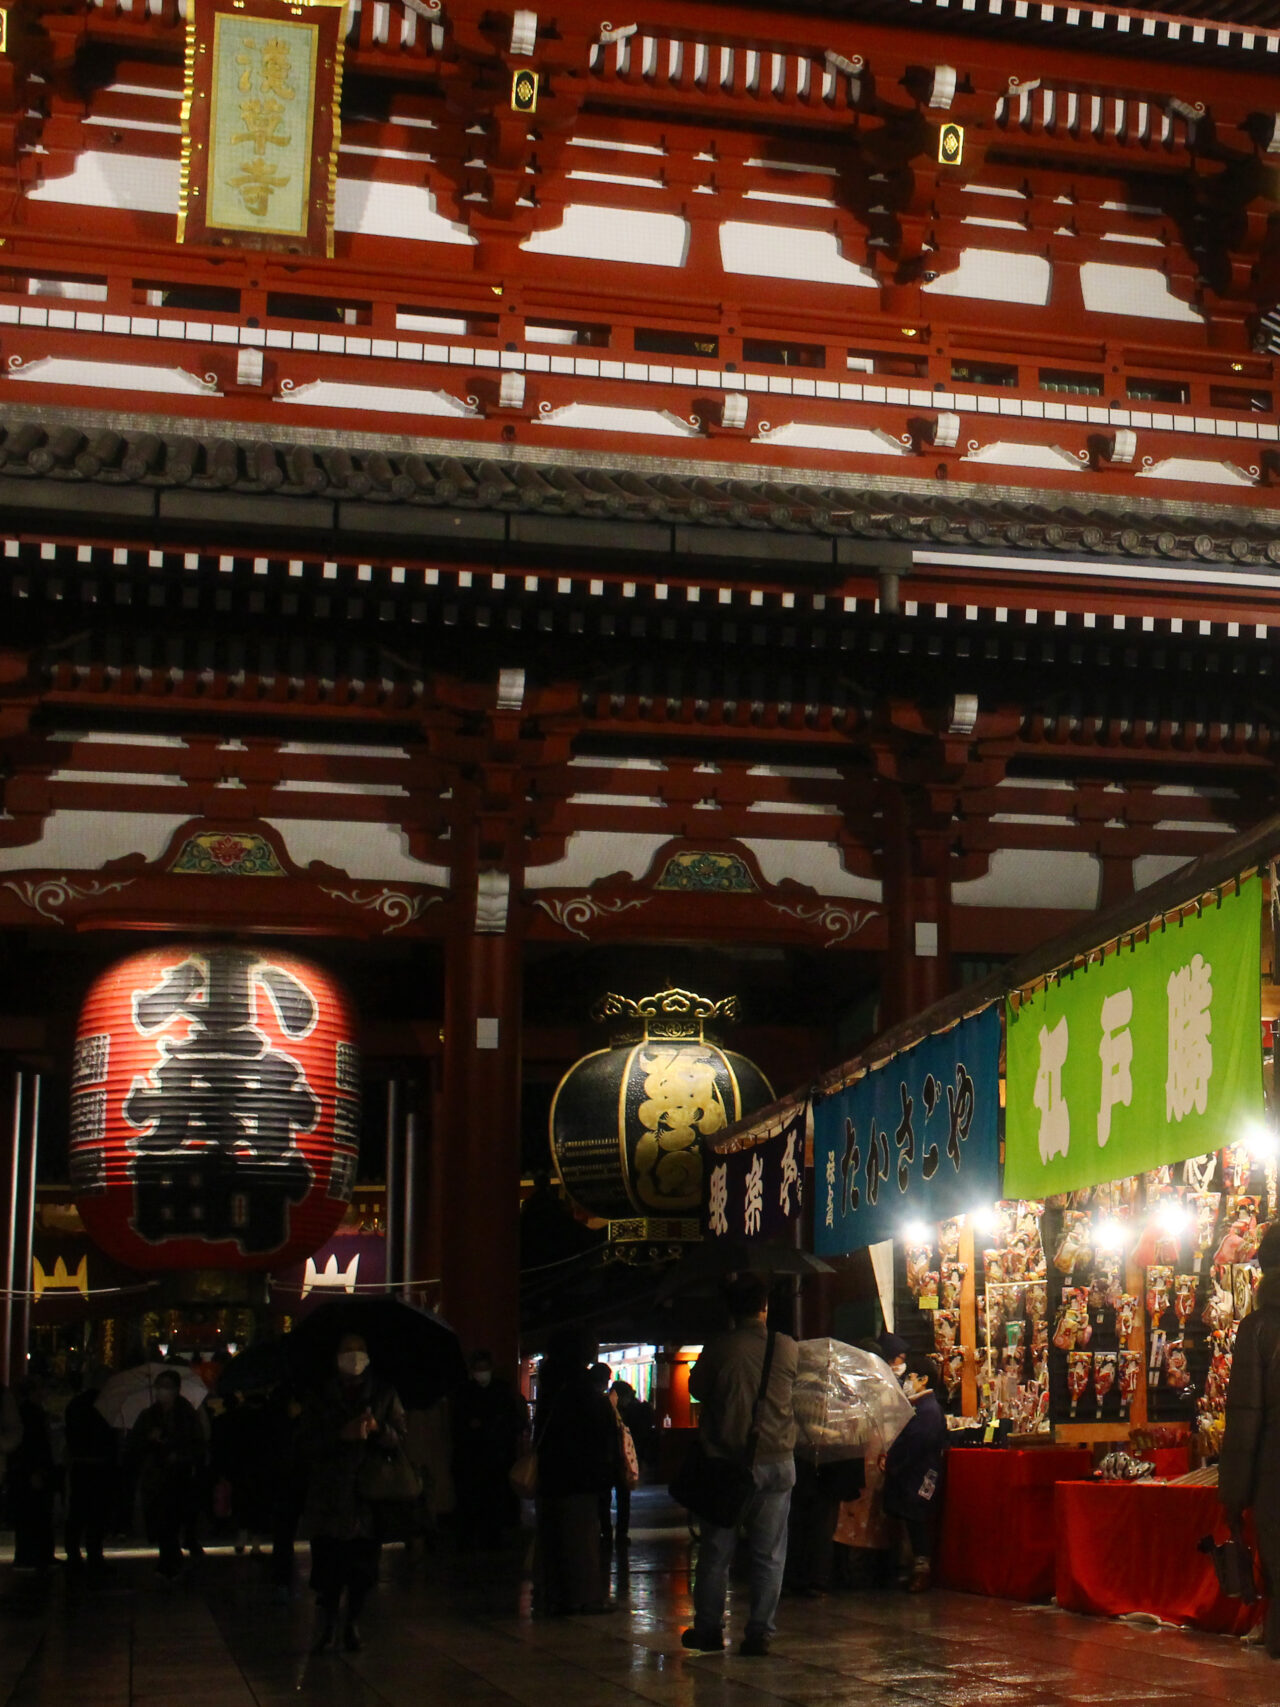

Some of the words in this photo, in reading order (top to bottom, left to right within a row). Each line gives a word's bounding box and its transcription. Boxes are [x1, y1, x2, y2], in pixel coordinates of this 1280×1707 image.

[841, 1063, 975, 1218] たかさごや
[1033, 953, 1213, 1166] 江戸勝
